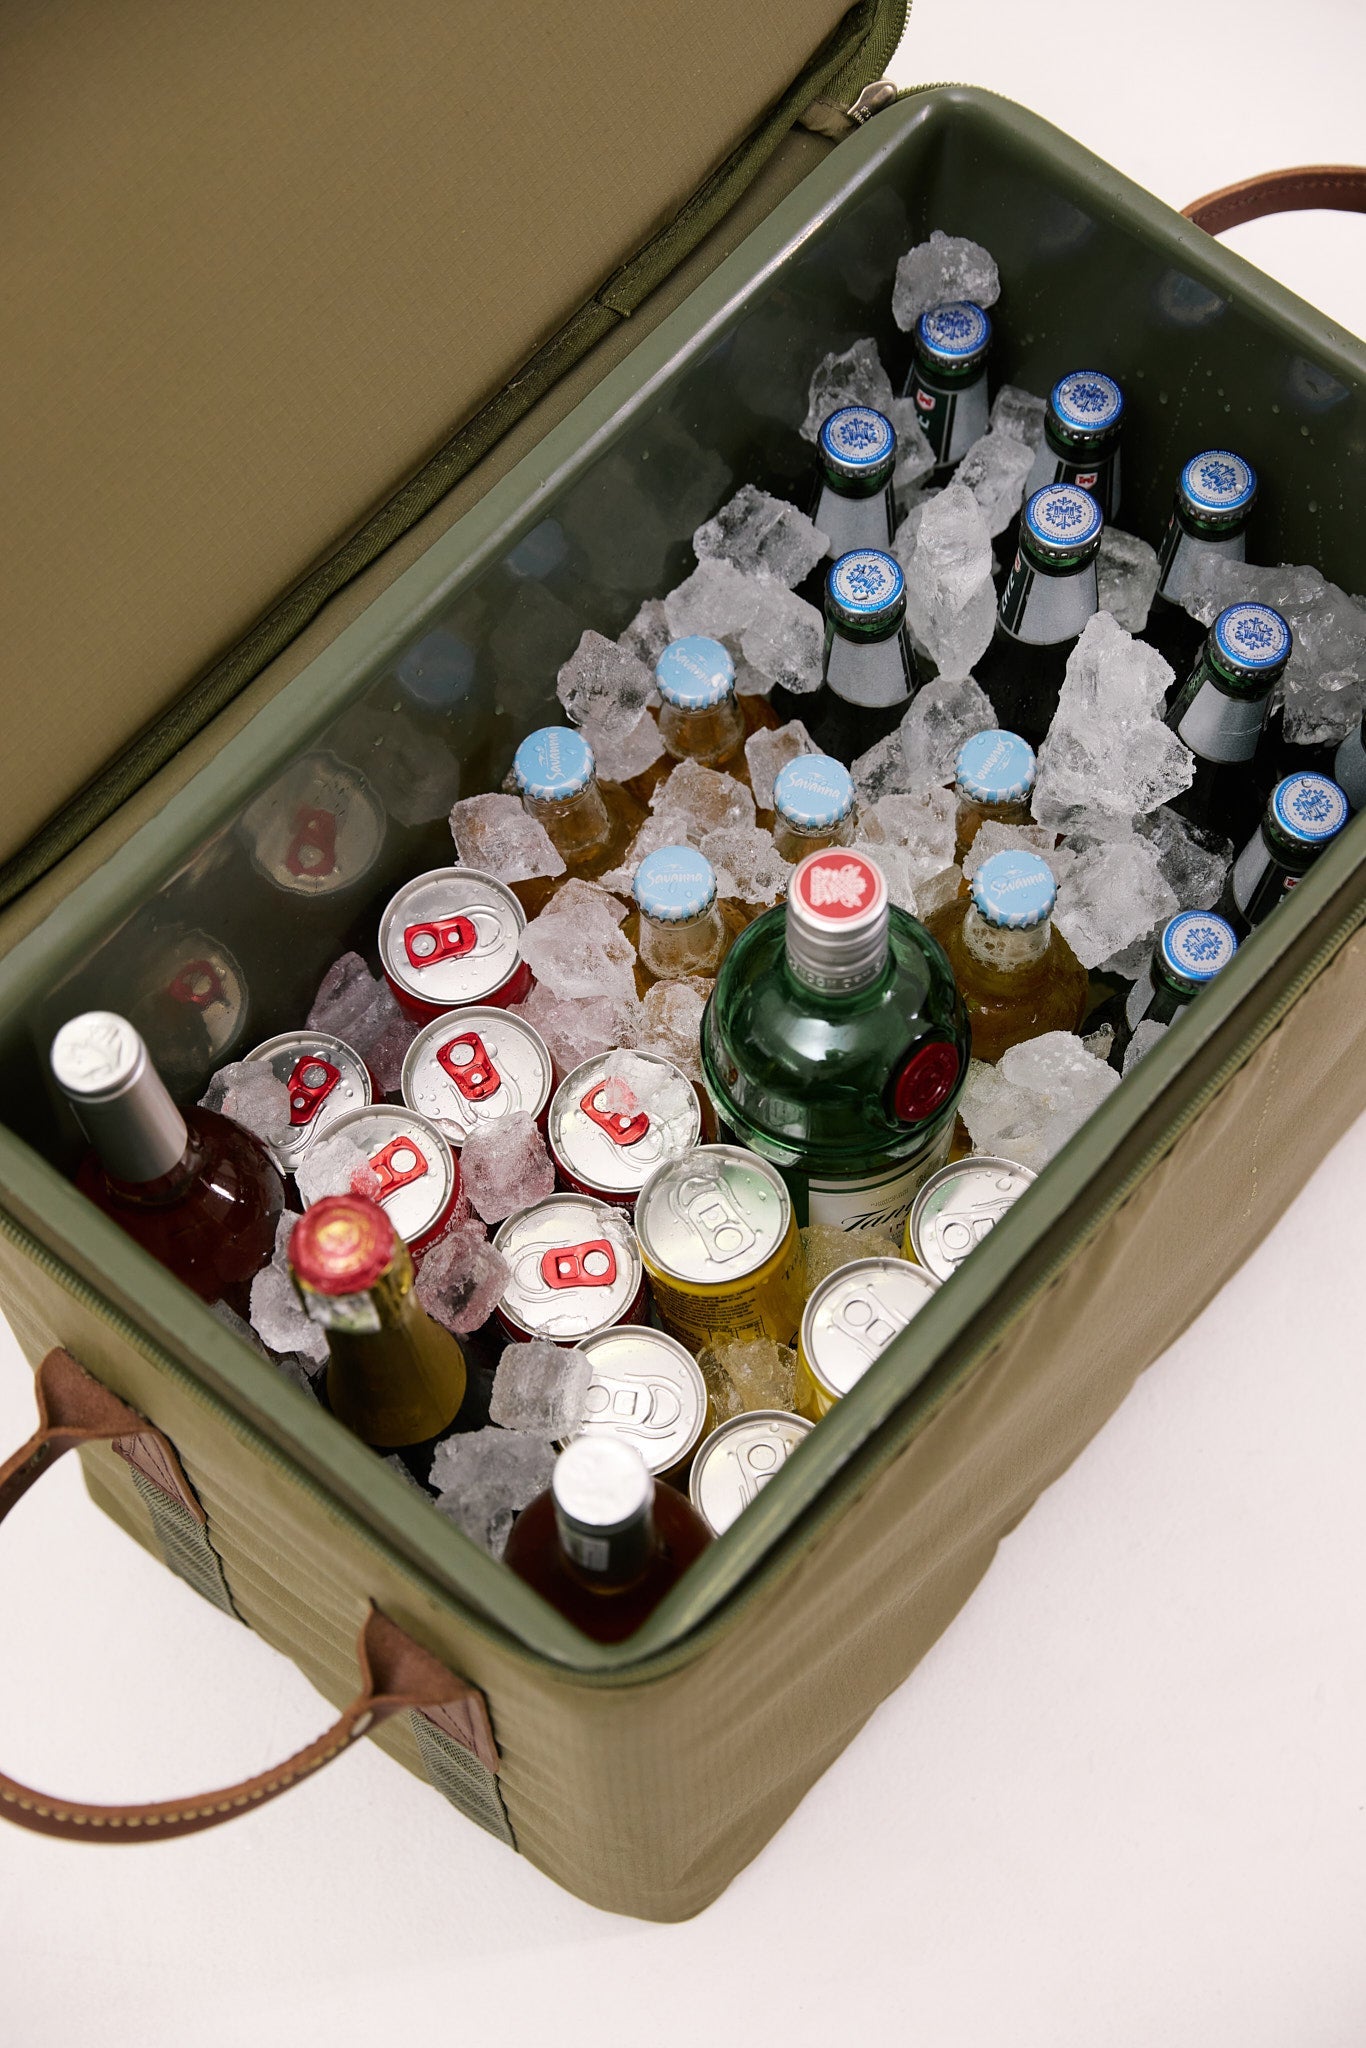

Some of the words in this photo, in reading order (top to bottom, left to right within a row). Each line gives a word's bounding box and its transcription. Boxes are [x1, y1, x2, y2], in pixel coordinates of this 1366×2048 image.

[545, 732, 566, 781] Savanna
[976, 736, 1014, 780] Savanna
[784, 771, 841, 799] Savanna
[646, 869, 704, 889] Savanna
[990, 872, 1047, 900] Savanna
